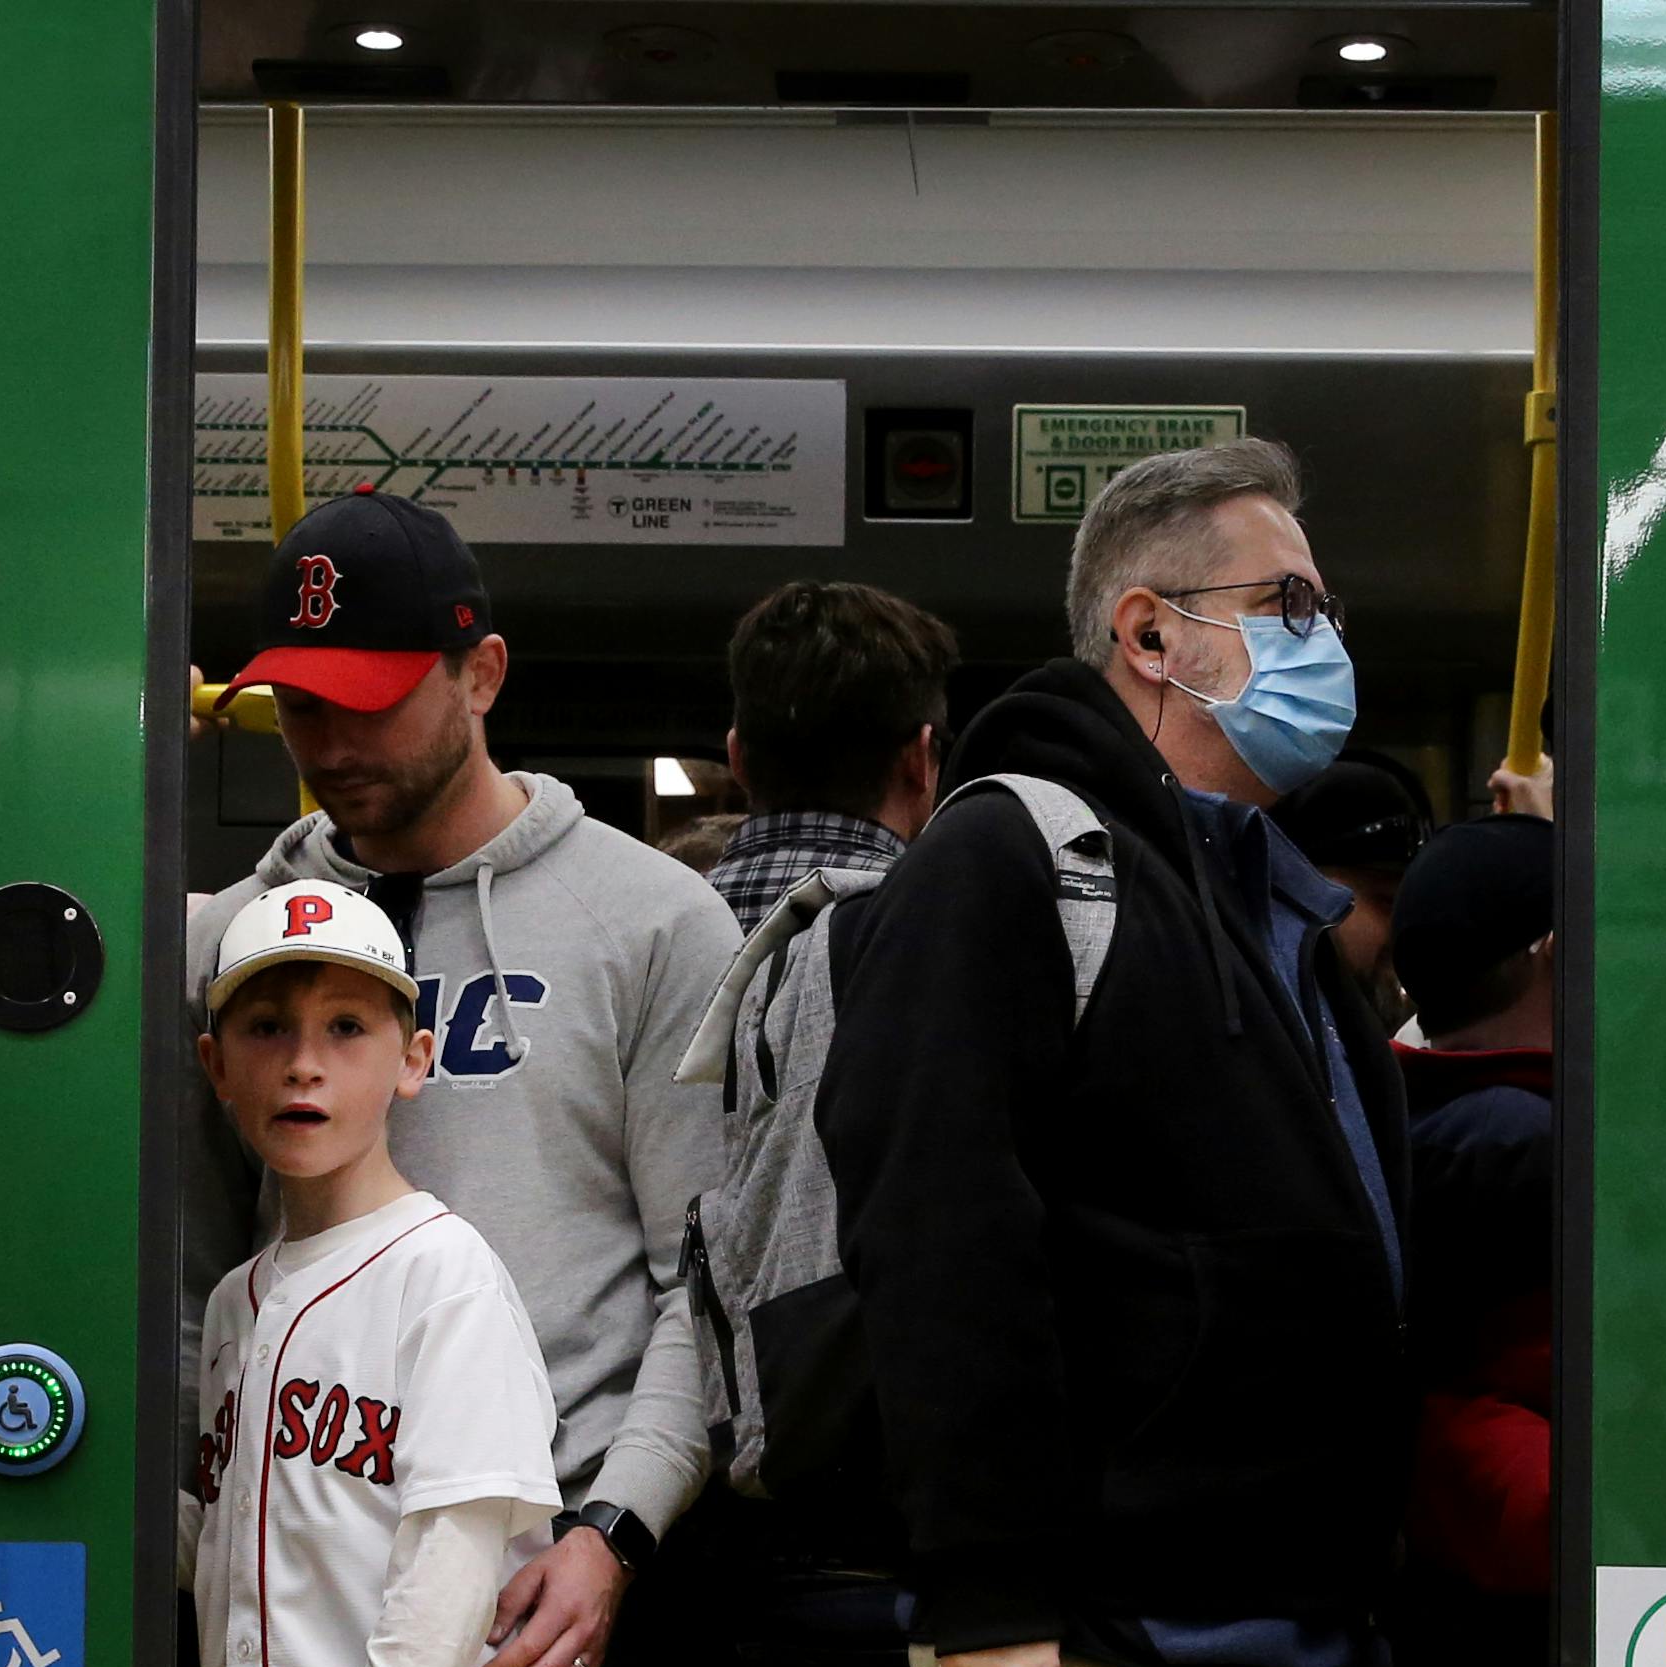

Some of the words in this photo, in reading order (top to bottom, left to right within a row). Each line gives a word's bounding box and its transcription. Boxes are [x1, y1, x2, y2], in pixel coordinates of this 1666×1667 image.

[1040, 418, 1150, 433] EMERGENCY
[1156, 419, 1215, 433] BRAKE
[1050, 436, 1063, 449] &
[1069, 436, 1121, 449] DOOR
[1126, 436, 1203, 450] RELEASE
[632, 497, 692, 512] GREEN
[632, 515, 670, 529] LINE
[288, 554, 344, 629] B
[283, 895, 333, 939] P
[274, 1378, 402, 1486] SOX
